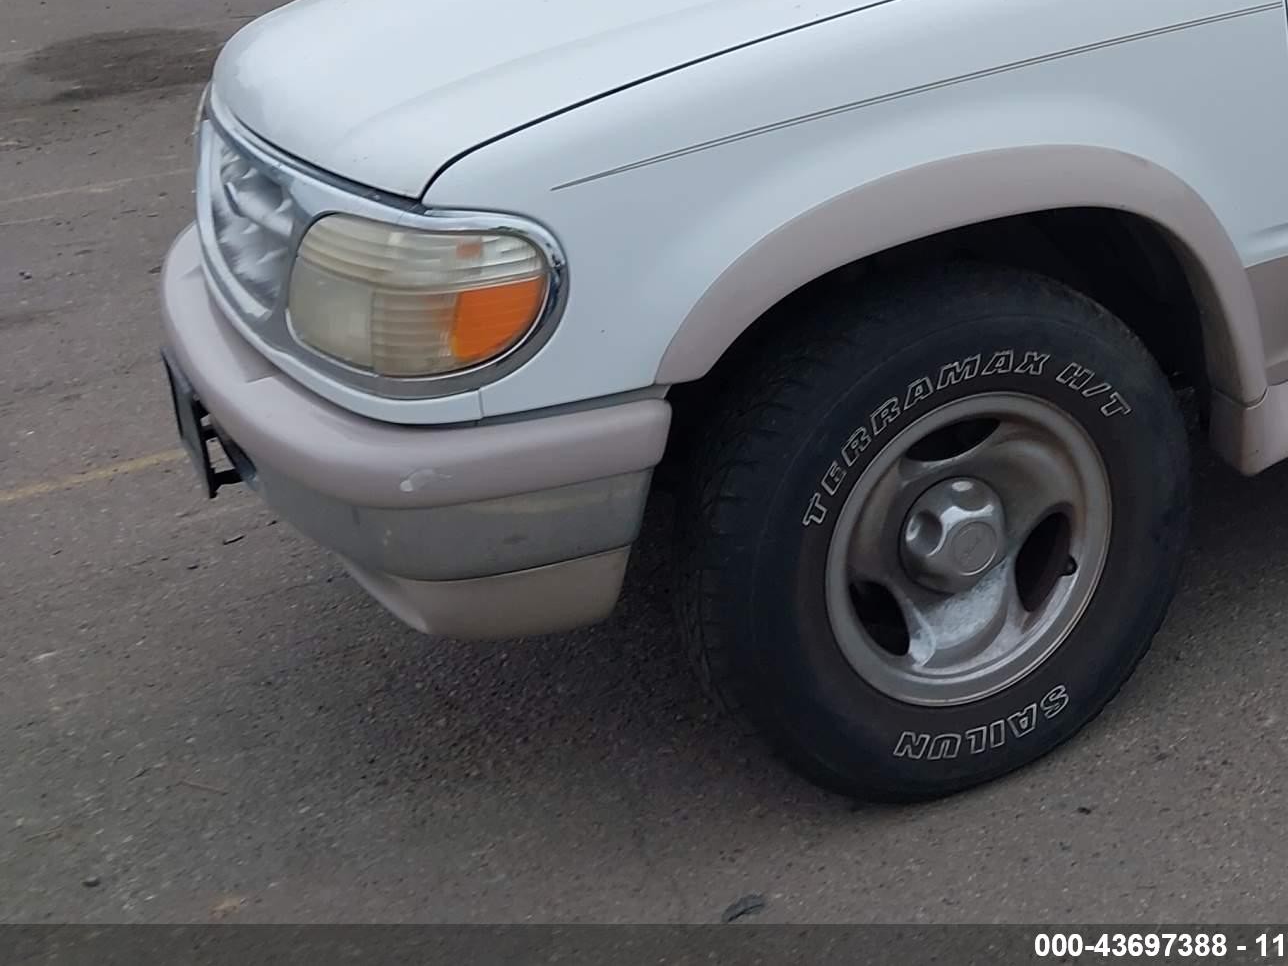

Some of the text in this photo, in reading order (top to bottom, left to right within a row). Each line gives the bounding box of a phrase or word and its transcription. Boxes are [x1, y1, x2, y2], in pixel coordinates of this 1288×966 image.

[802, 349, 1132, 529] TERRAMAX H/T
[894, 684, 1069, 760] SAILUN
